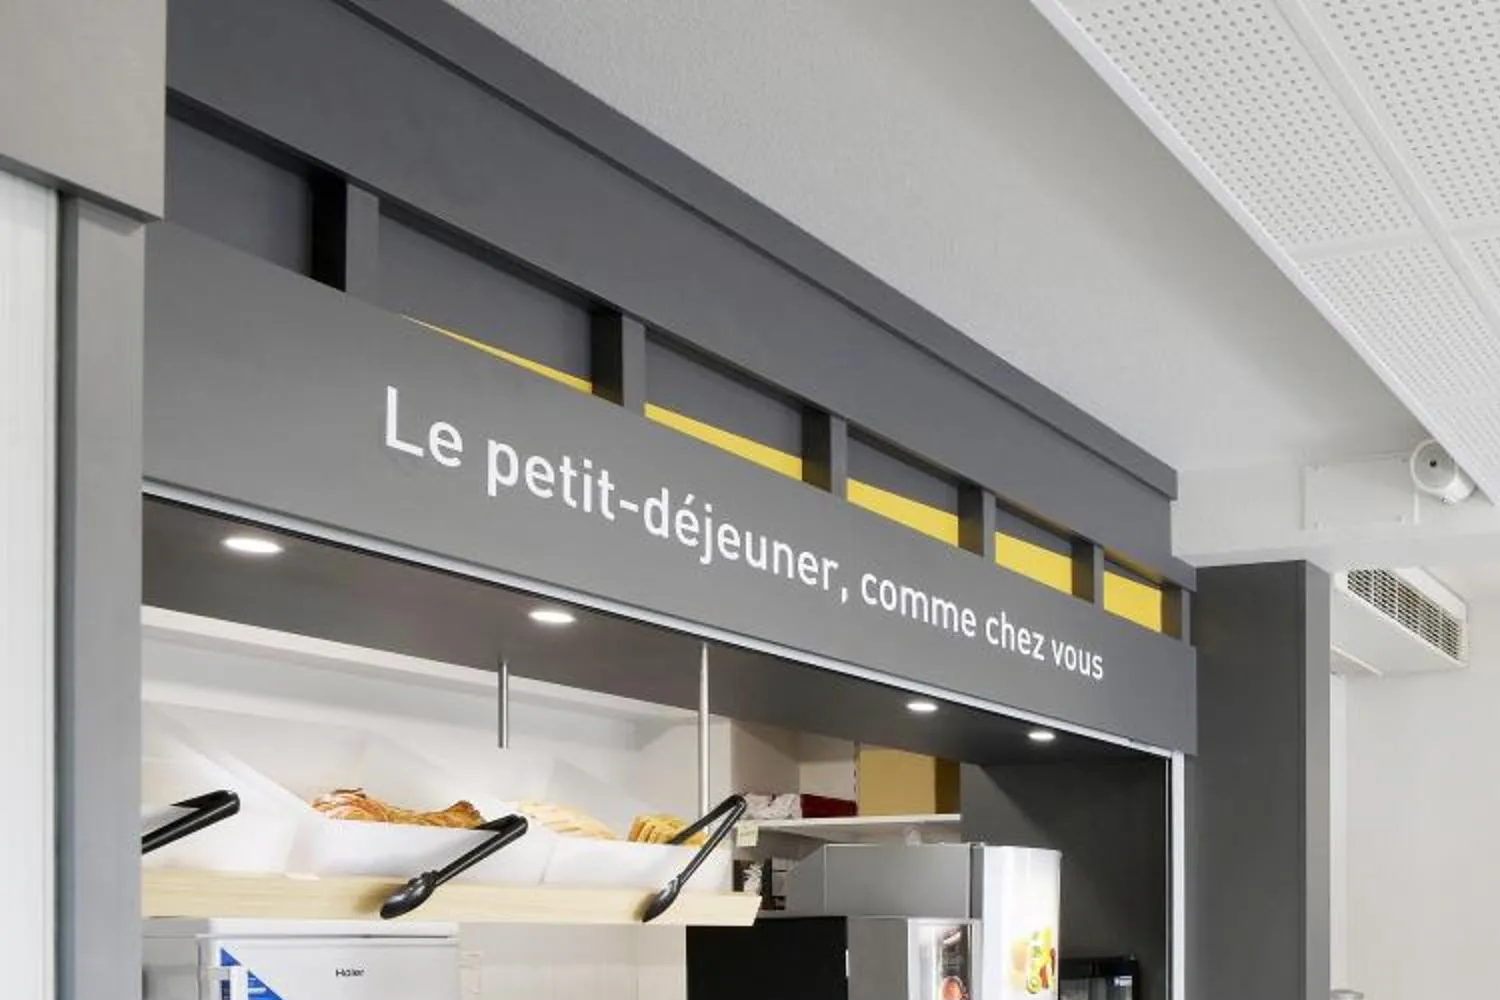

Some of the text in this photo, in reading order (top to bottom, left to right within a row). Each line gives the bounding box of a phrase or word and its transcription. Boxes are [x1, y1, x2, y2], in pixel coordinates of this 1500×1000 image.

[385, 385, 1104, 681] Le petit-déjeuner, comme chez vous
